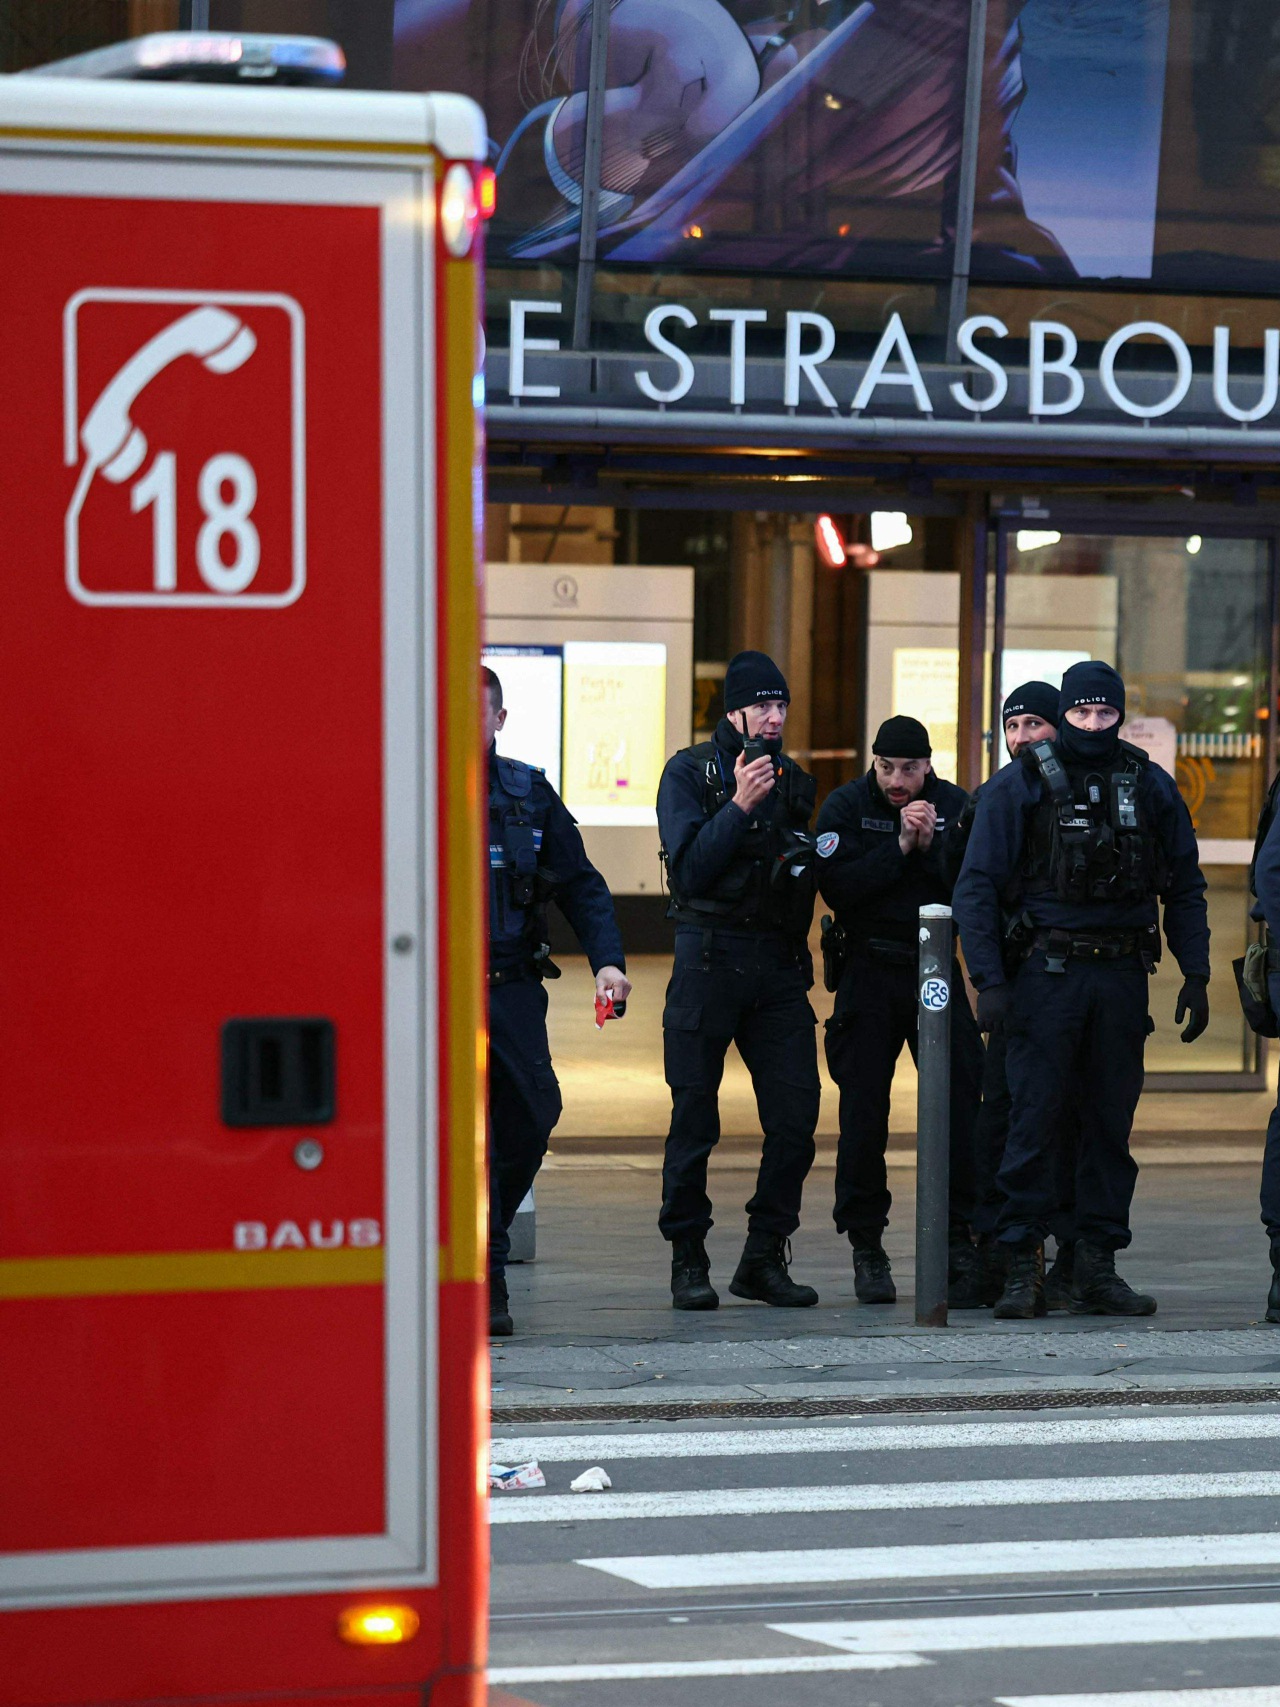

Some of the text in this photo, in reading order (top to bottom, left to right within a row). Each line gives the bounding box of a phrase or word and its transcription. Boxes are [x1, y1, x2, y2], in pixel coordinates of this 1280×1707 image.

[131, 451, 261, 594] 18
[1075, 696, 1106, 705] POLICE
[863, 819, 893, 831] POLICE
[232, 1218, 381, 1251] BAUS
